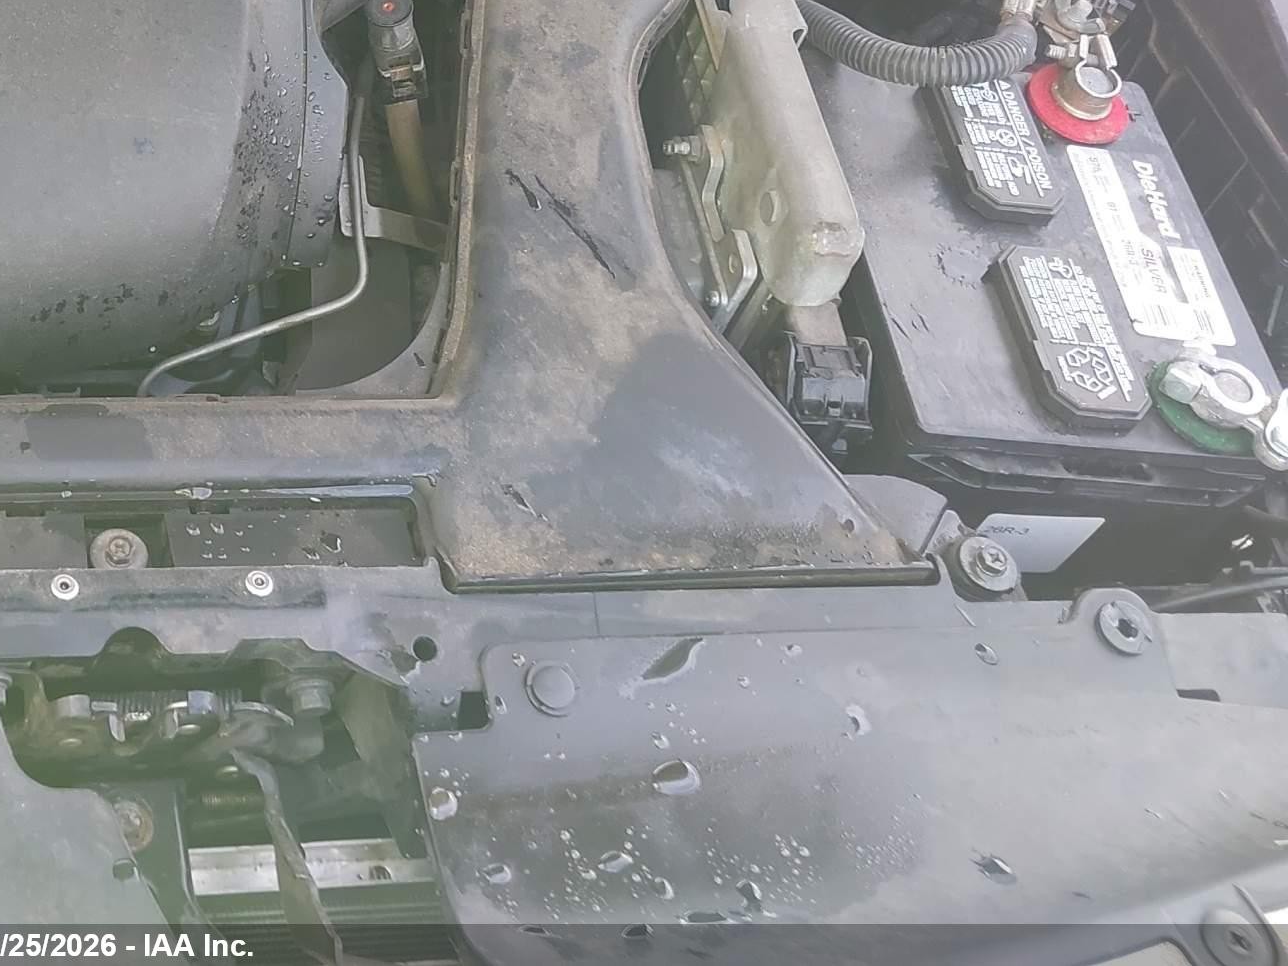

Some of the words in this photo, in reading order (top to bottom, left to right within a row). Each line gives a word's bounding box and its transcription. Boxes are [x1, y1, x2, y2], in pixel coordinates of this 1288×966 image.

[1003, 90, 1031, 137] DANGER
[1025, 145, 1053, 190] POISON
[1132, 159, 1182, 240] DieHard
[1140, 246, 1168, 295] SILVER
